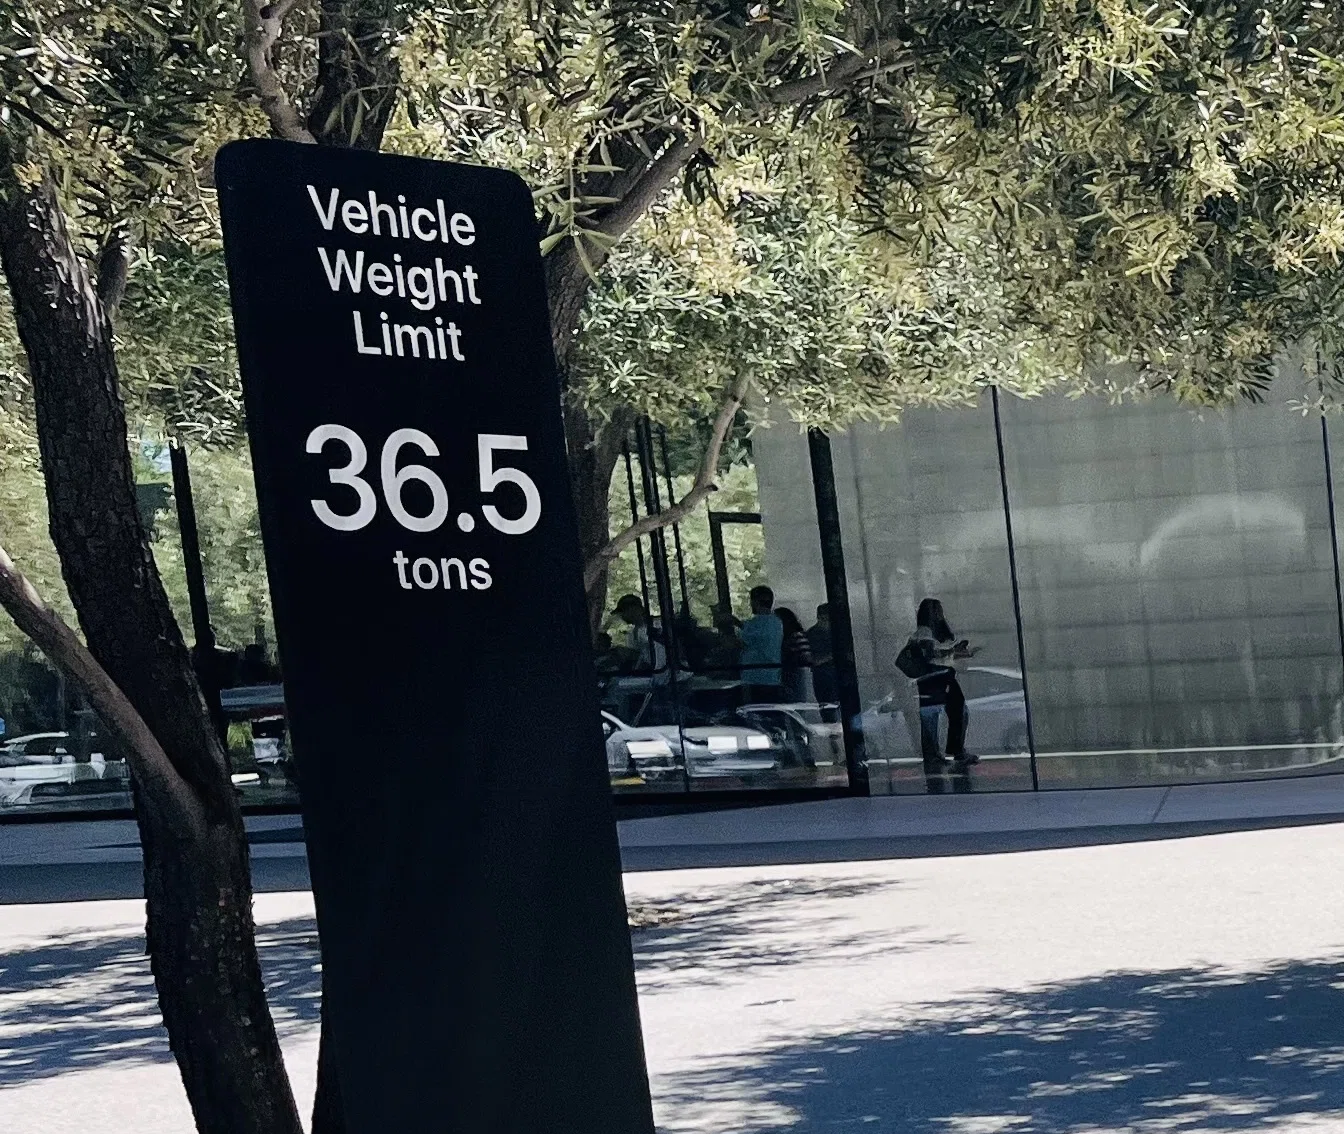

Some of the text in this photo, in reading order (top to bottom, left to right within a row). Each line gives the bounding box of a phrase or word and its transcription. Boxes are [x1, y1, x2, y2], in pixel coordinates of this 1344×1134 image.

[306, 184, 476, 246] Vehicle
[317, 247, 482, 311] Weight
[353, 311, 466, 362] Limit
[305, 424, 542, 535] 36.5
[393, 550, 493, 590] tons
